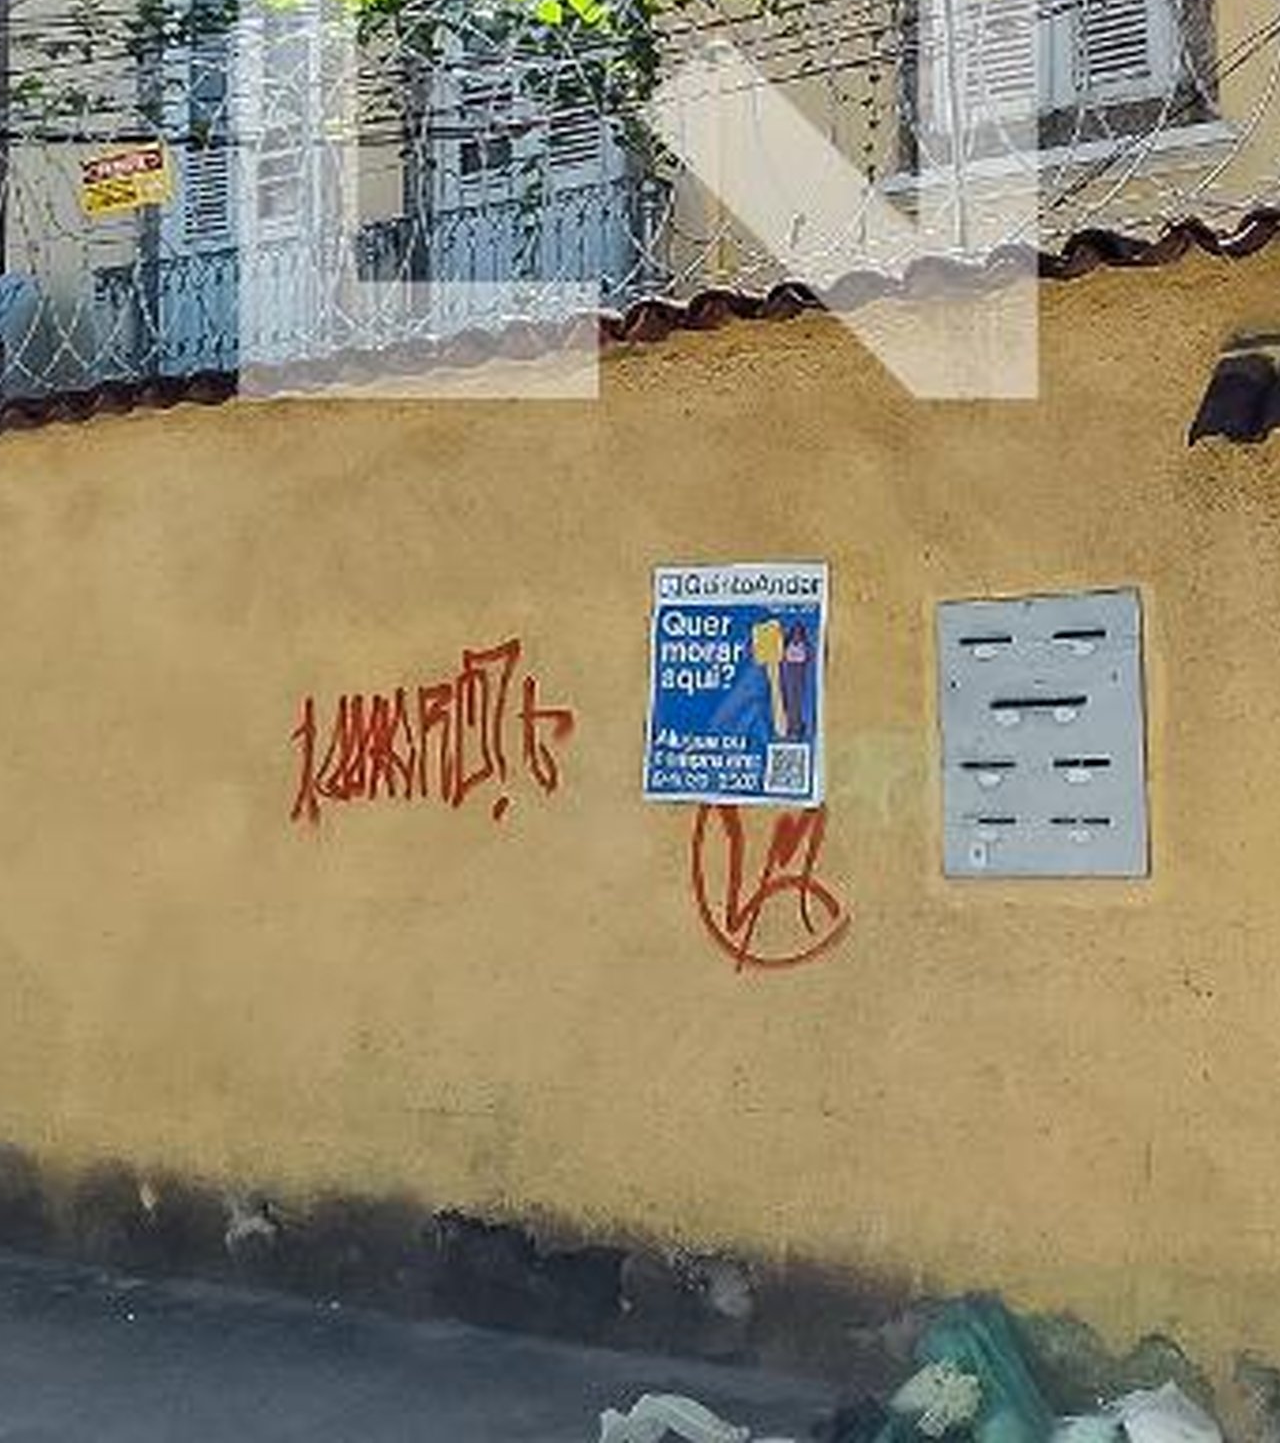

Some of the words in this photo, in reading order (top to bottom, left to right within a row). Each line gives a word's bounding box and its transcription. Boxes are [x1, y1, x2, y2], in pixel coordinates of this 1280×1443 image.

[684, 573, 821, 596] QuintoAndar
[661, 611, 734, 637] Quer
[661, 640, 745, 663] morar
[661, 664, 735, 695] aqui?
